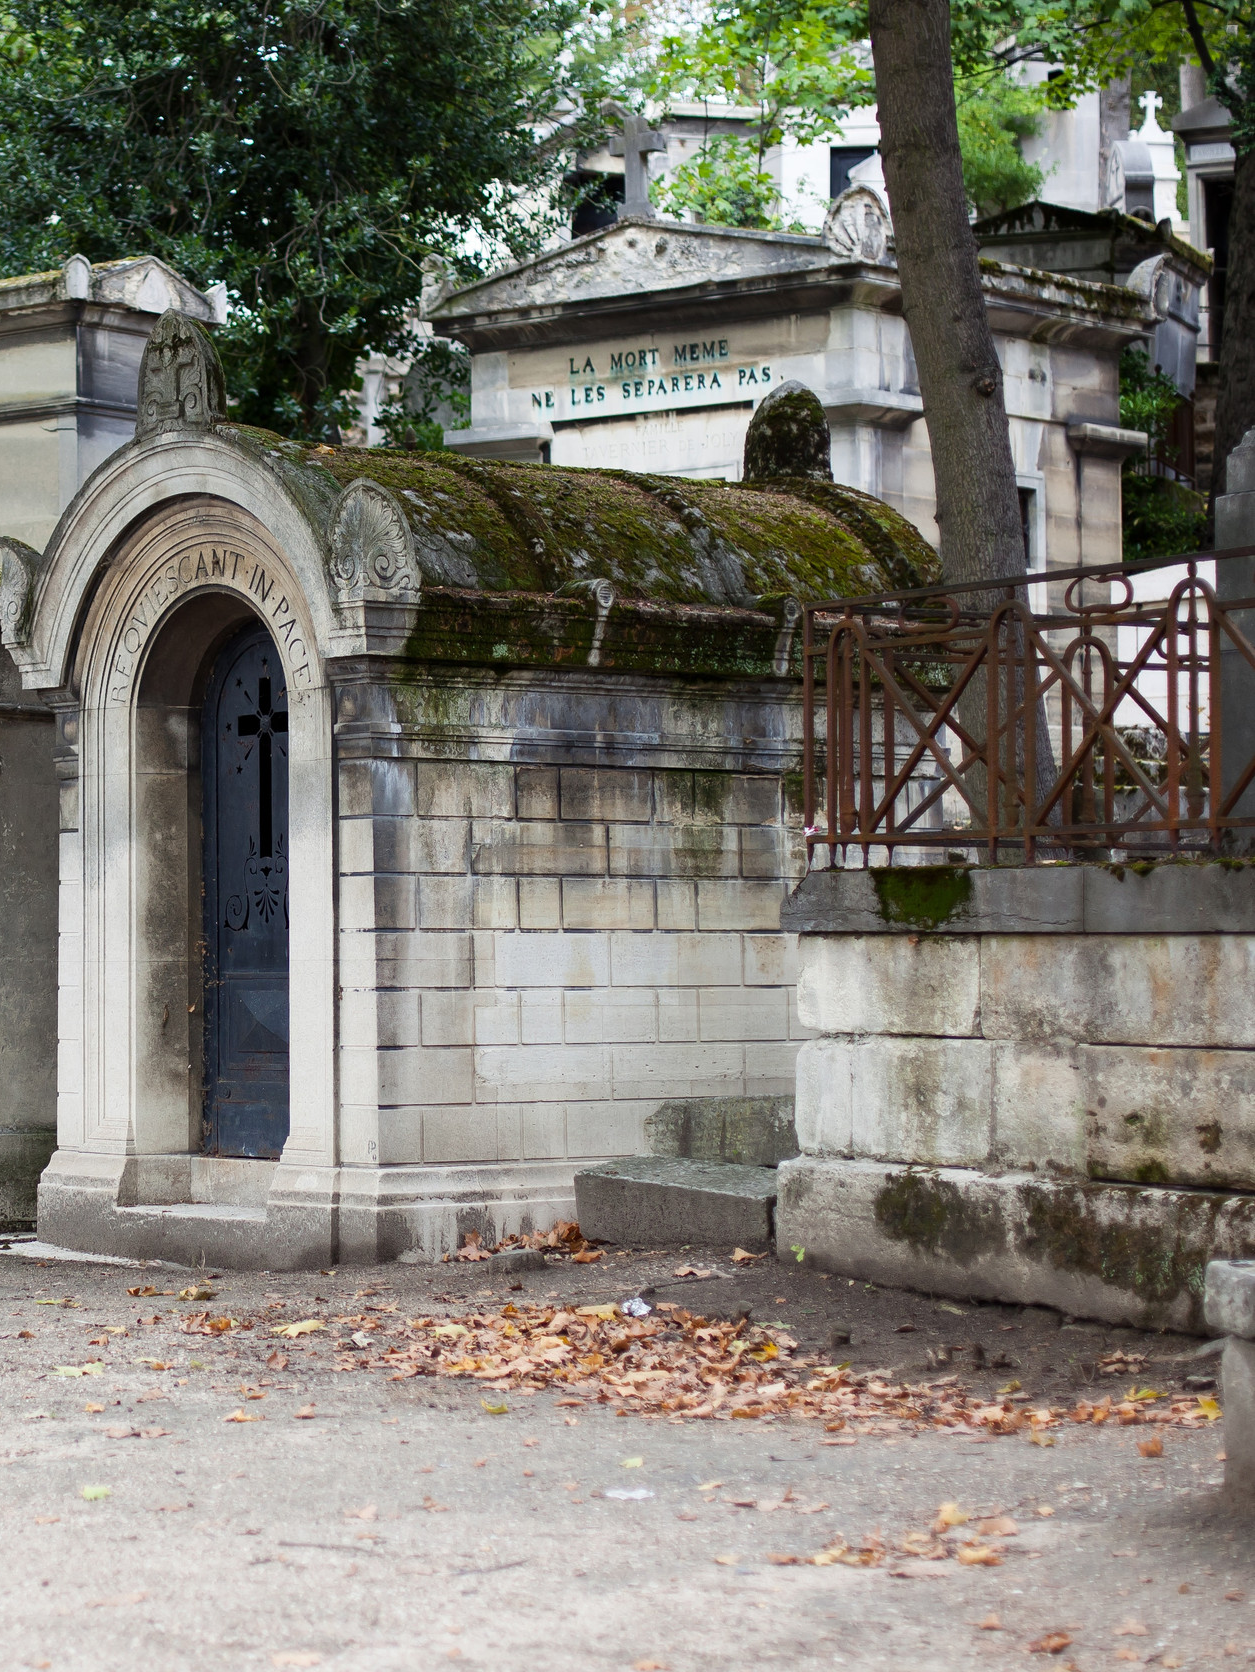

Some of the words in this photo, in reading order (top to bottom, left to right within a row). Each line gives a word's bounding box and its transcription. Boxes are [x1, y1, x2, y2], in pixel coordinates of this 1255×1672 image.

[569, 356, 595, 375] LA
[610, 348, 659, 371] MORT
[674, 339, 729, 363] MEME
[531, 390, 555, 408] NE
[571, 385, 606, 406] LES
[622, 372, 722, 399] SEPARERA
[584, 439, 668, 462] TAVERNIER
[678, 438, 695, 452] DE
[703, 431, 739, 449] JOLY
[635, 420, 684, 437] FAMILLE
[249, 563, 275, 603] IN
[272, 595, 311, 689] PACE
